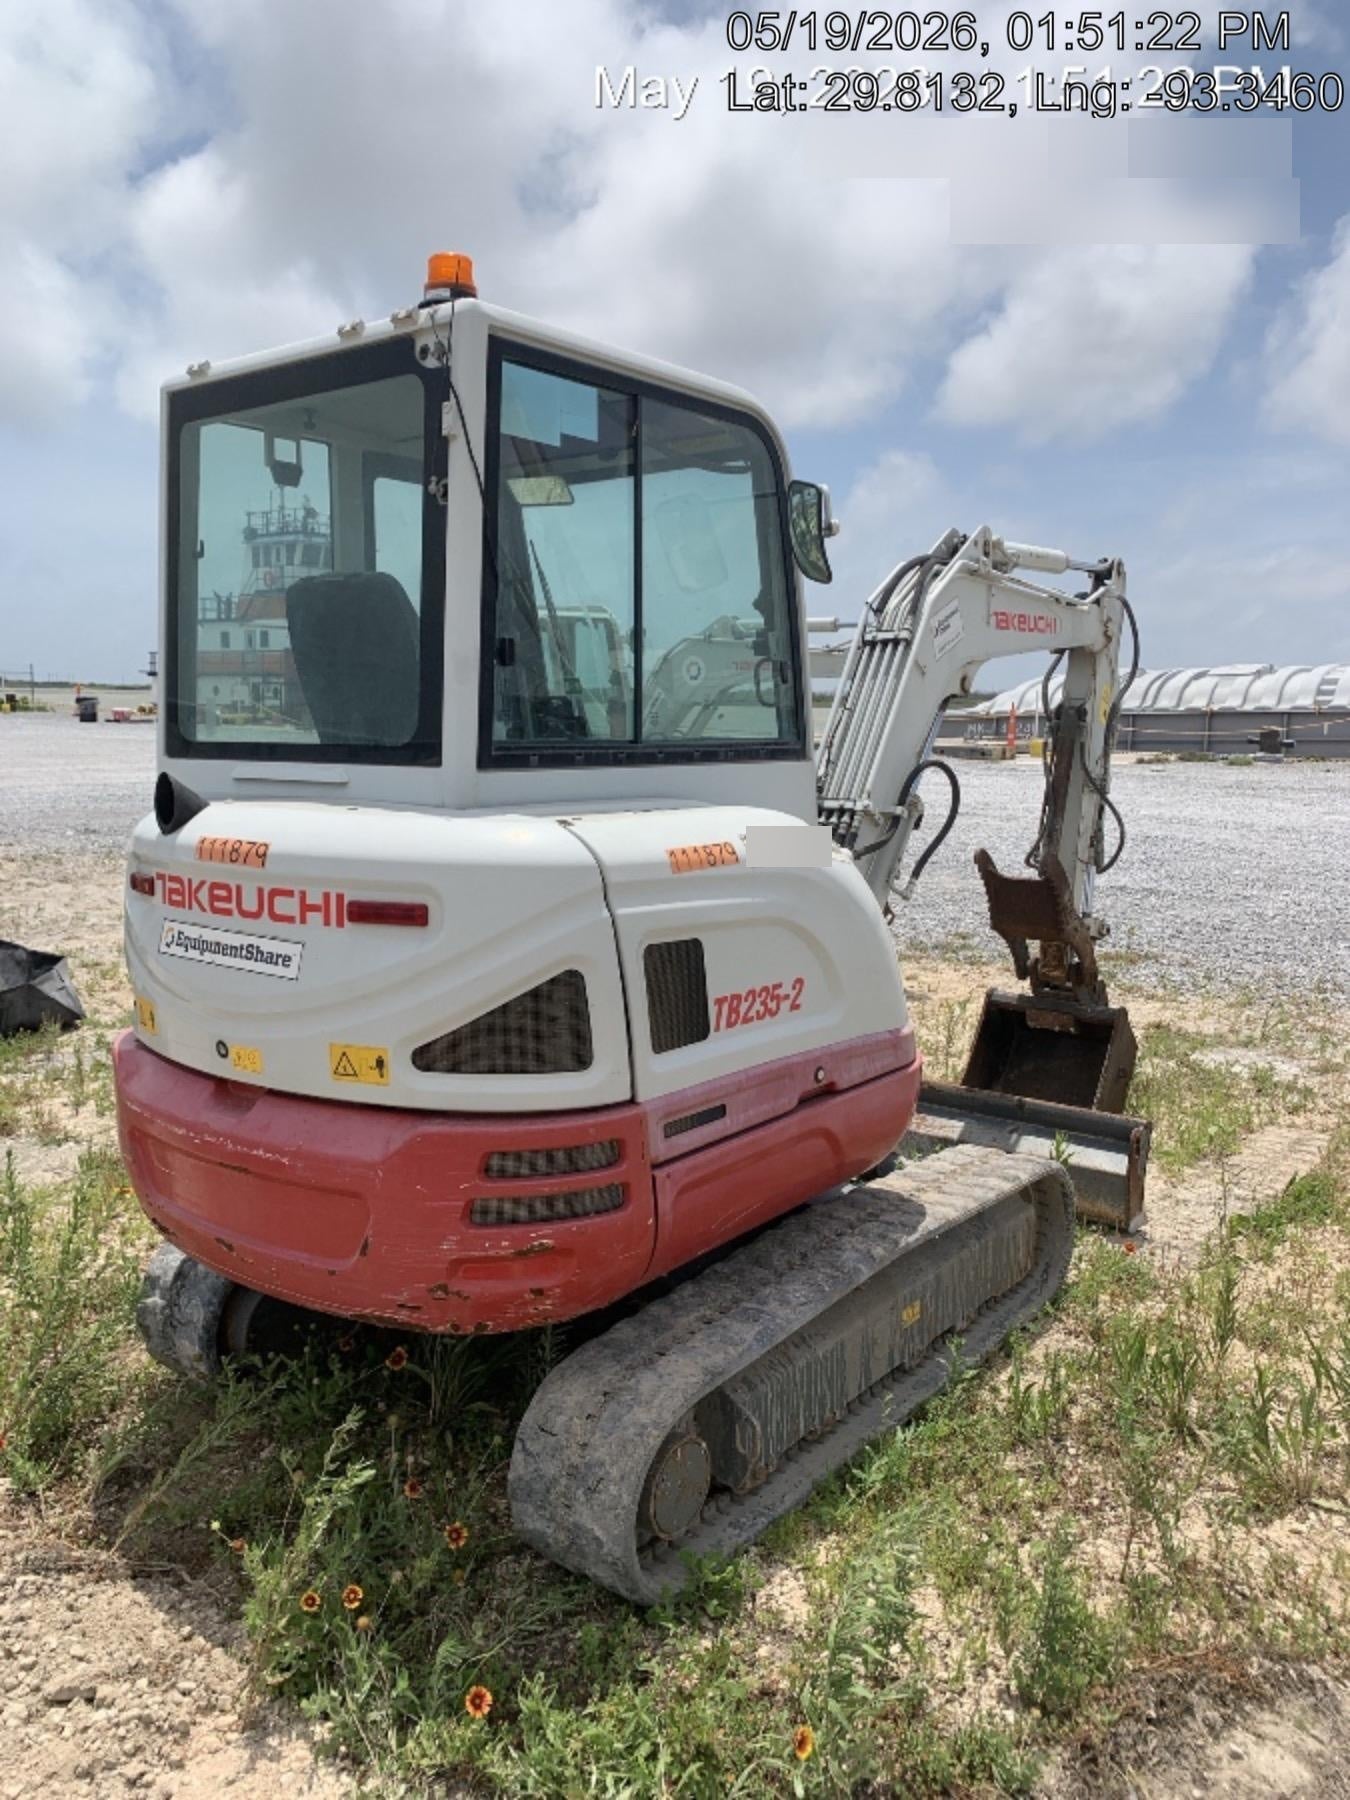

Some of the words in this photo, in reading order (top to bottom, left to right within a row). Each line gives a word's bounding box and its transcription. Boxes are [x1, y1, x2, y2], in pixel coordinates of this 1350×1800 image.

[992, 610, 1058, 634] TAKEUCHI
[199, 837, 269, 868] 111879
[669, 841, 739, 872] 111879
[155, 871, 346, 928] TAKEUCHI
[175, 929, 293, 968] EquipmentShare
[713, 976, 805, 1033] TB235-2
